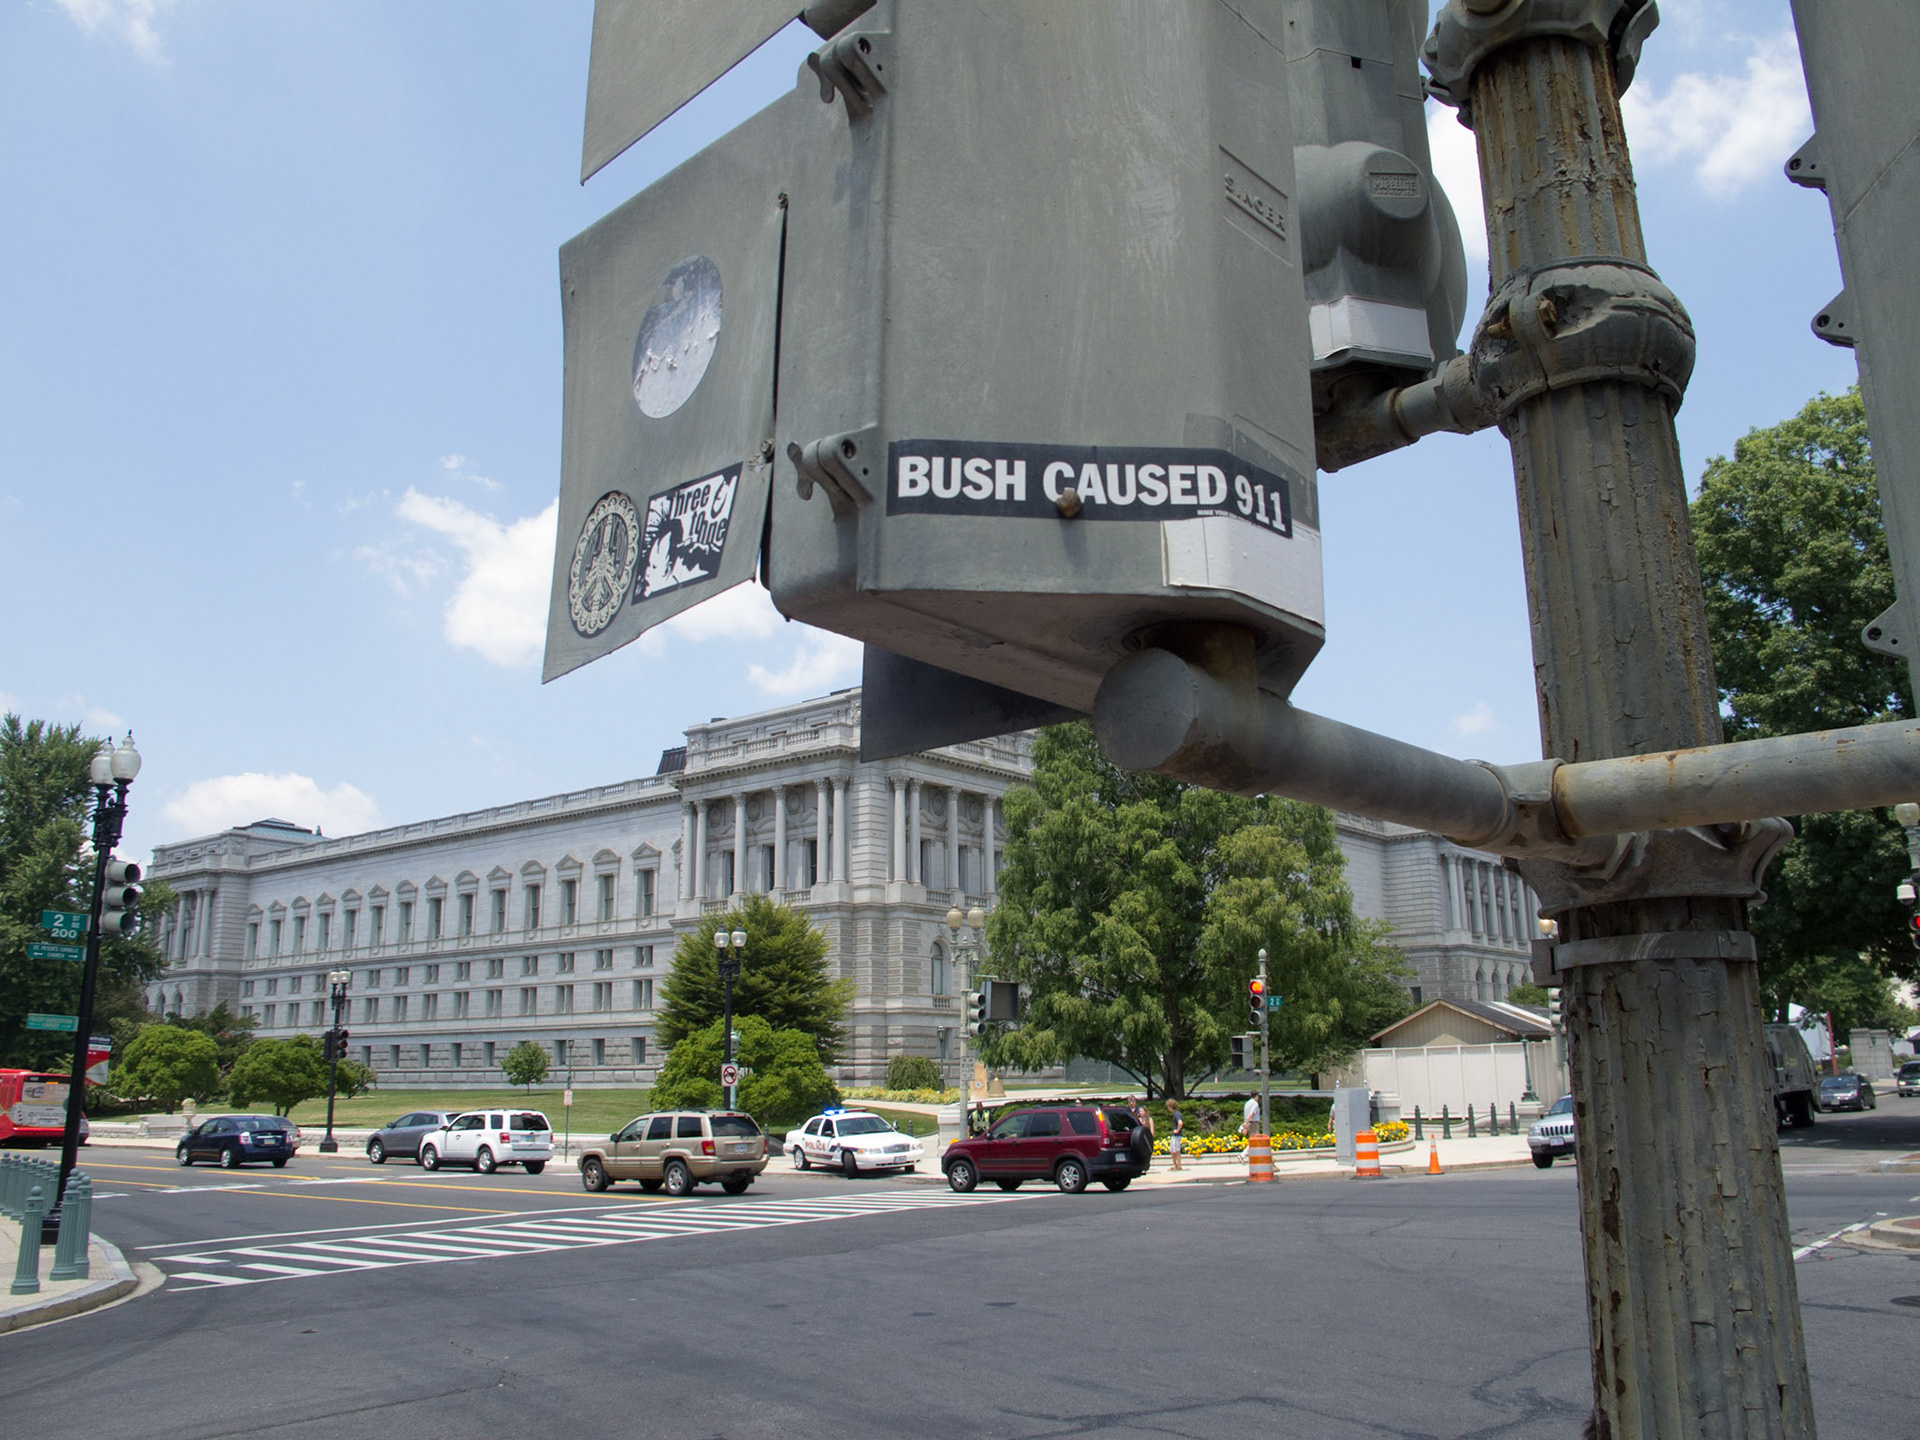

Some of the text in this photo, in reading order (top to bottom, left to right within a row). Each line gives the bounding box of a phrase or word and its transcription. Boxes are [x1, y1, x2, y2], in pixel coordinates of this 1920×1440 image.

[899, 456, 1287, 532] BUSH CAUSED 911
[53, 914, 64, 927] 2
[51, 928, 77, 939] 200
[805, 1141, 826, 1151] POLICE
